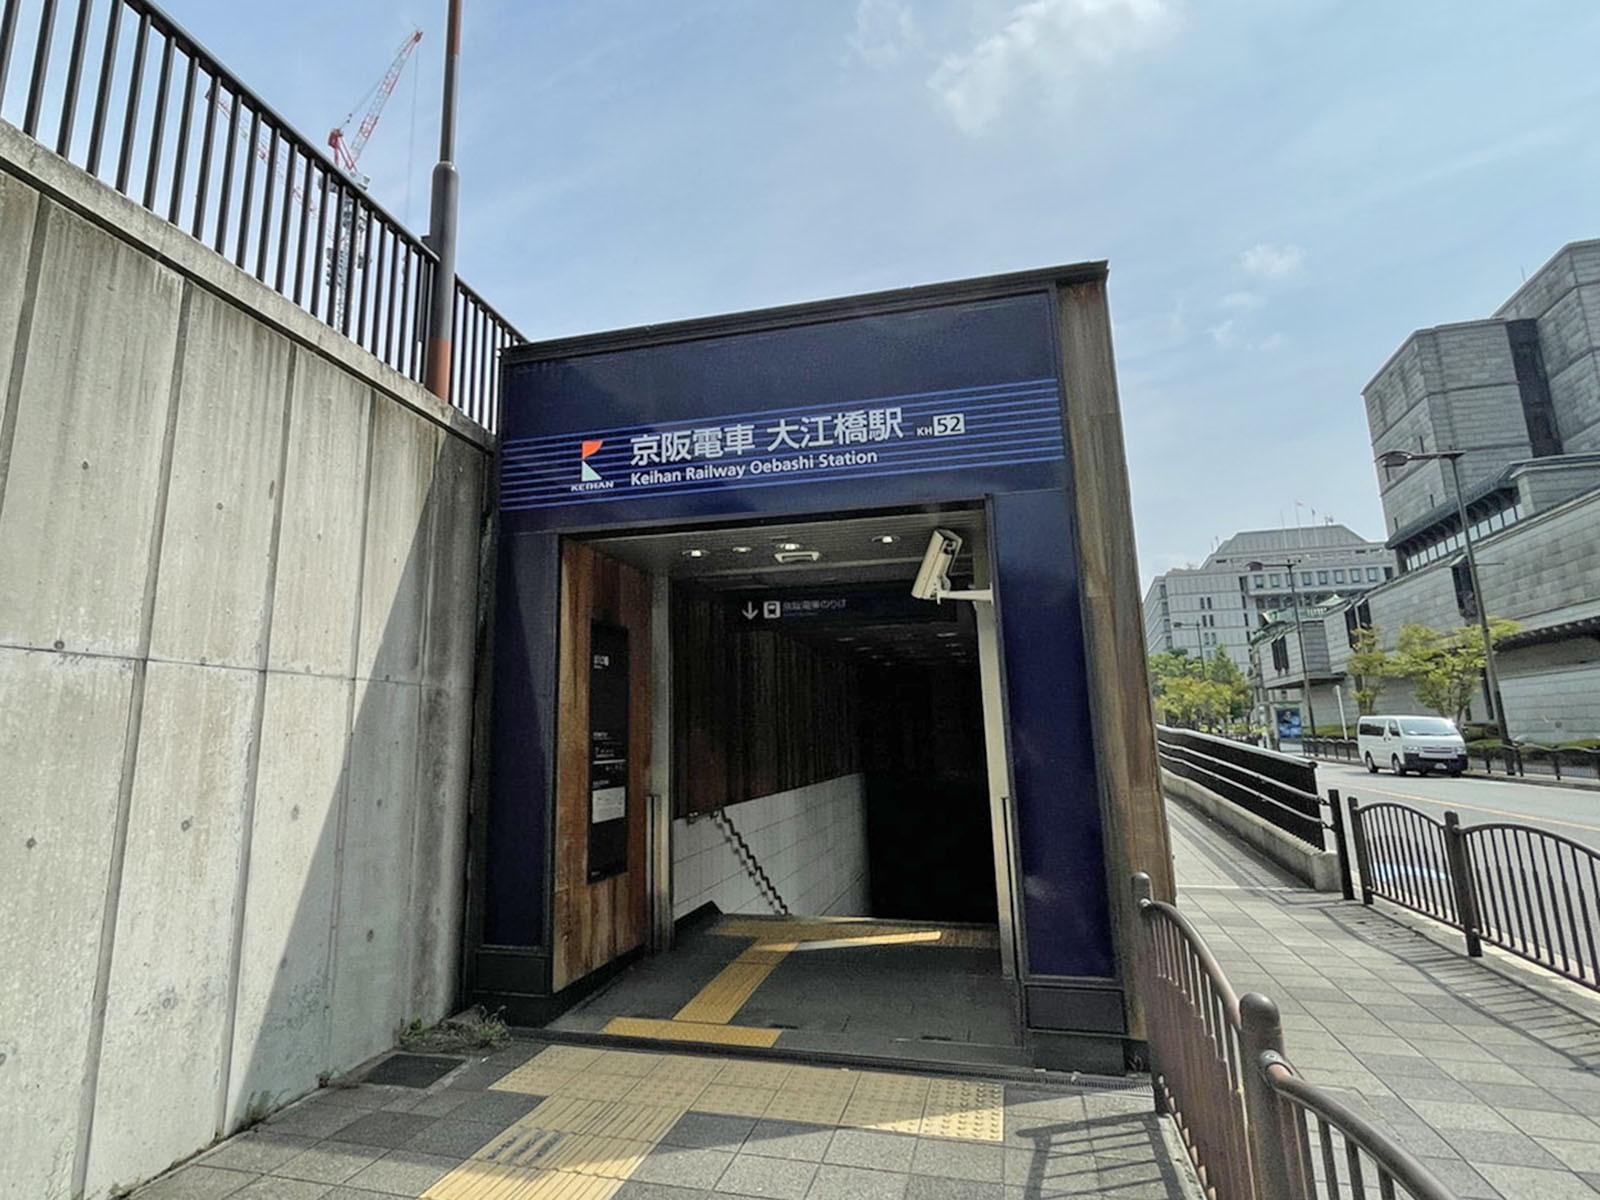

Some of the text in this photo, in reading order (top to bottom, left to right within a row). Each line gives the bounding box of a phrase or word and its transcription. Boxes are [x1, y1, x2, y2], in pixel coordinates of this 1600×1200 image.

[630, 407, 962, 466] 京阪電車 大江橋駅 KH 52
[630, 451, 878, 486] Keihan Railway Oebashi Station
[570, 481, 615, 492] KEIHAN
